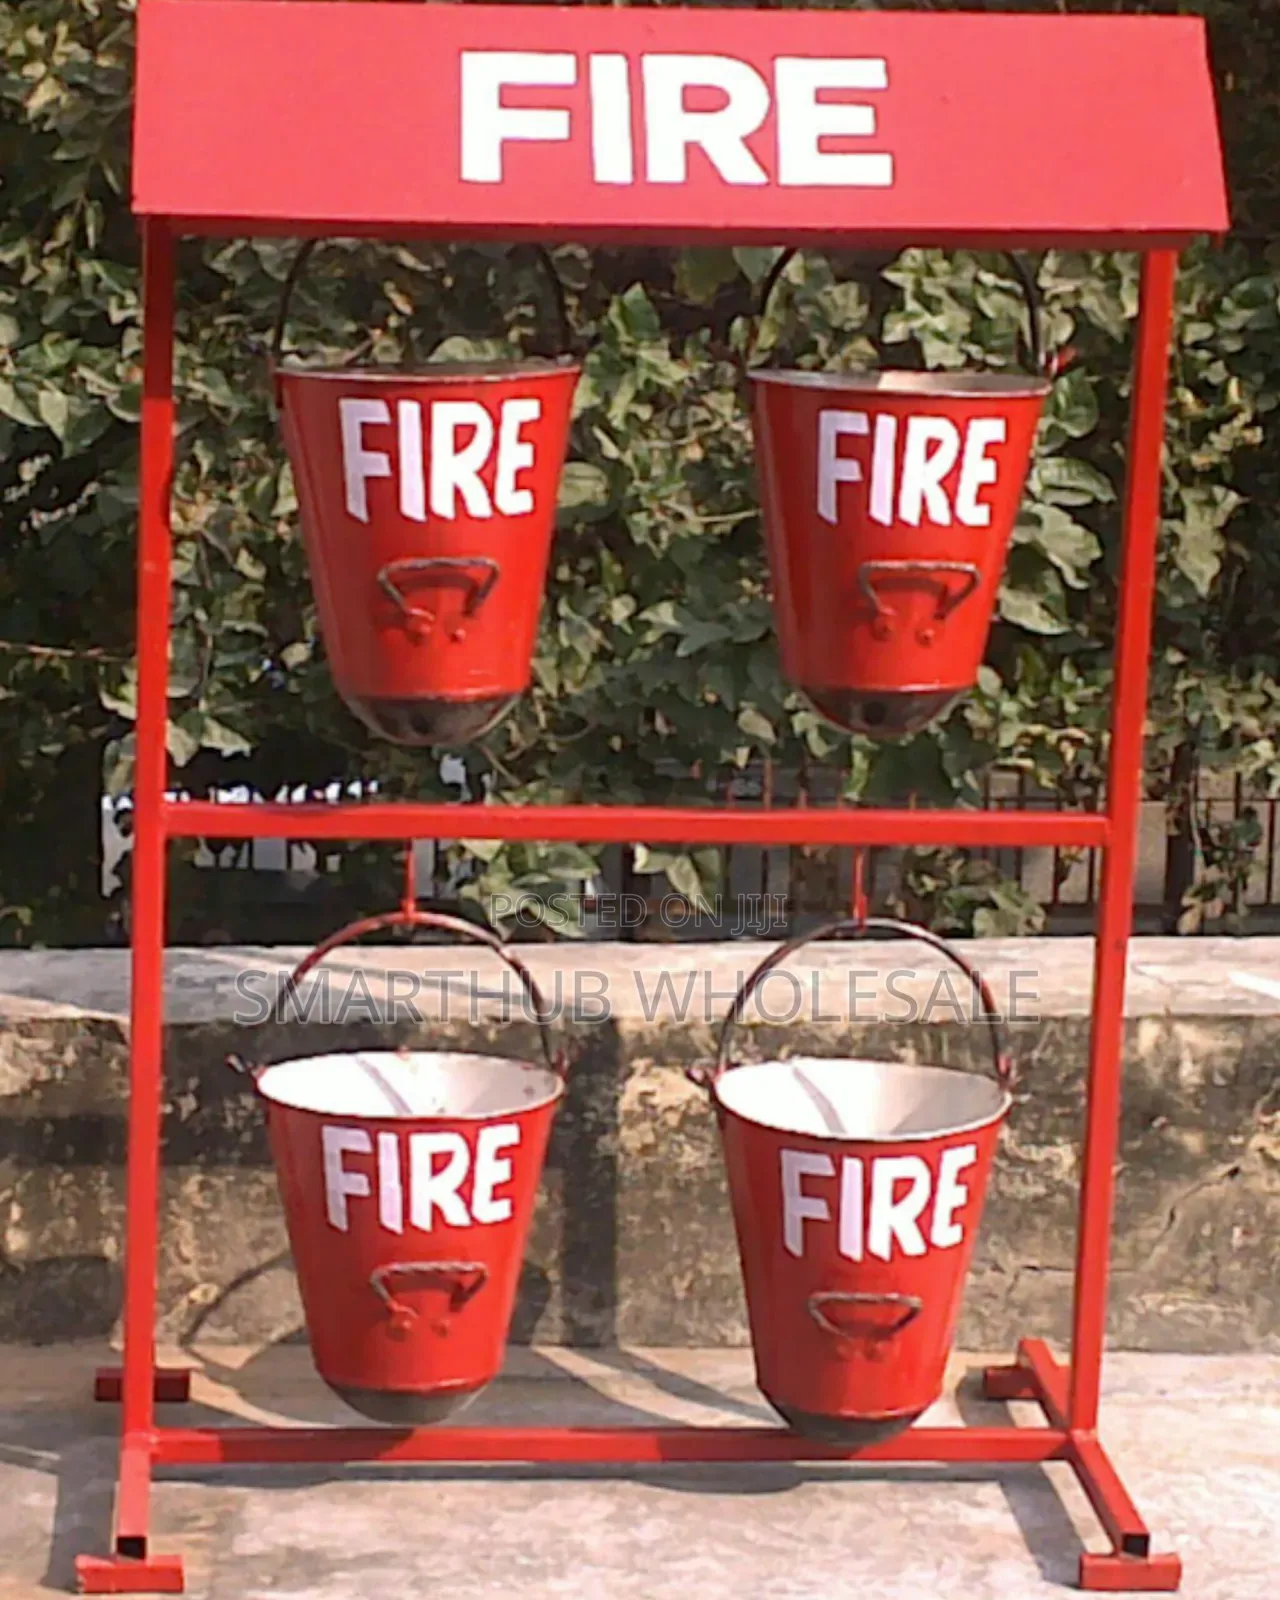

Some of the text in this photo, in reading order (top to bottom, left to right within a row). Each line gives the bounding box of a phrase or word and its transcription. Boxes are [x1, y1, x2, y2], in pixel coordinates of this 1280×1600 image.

[460, 51, 893, 187] FIRE
[338, 399, 540, 522] FIRE
[816, 410, 1006, 527] FIRE
[321, 1123, 521, 1235] FIRE
[780, 1144, 977, 1262] FIRE
